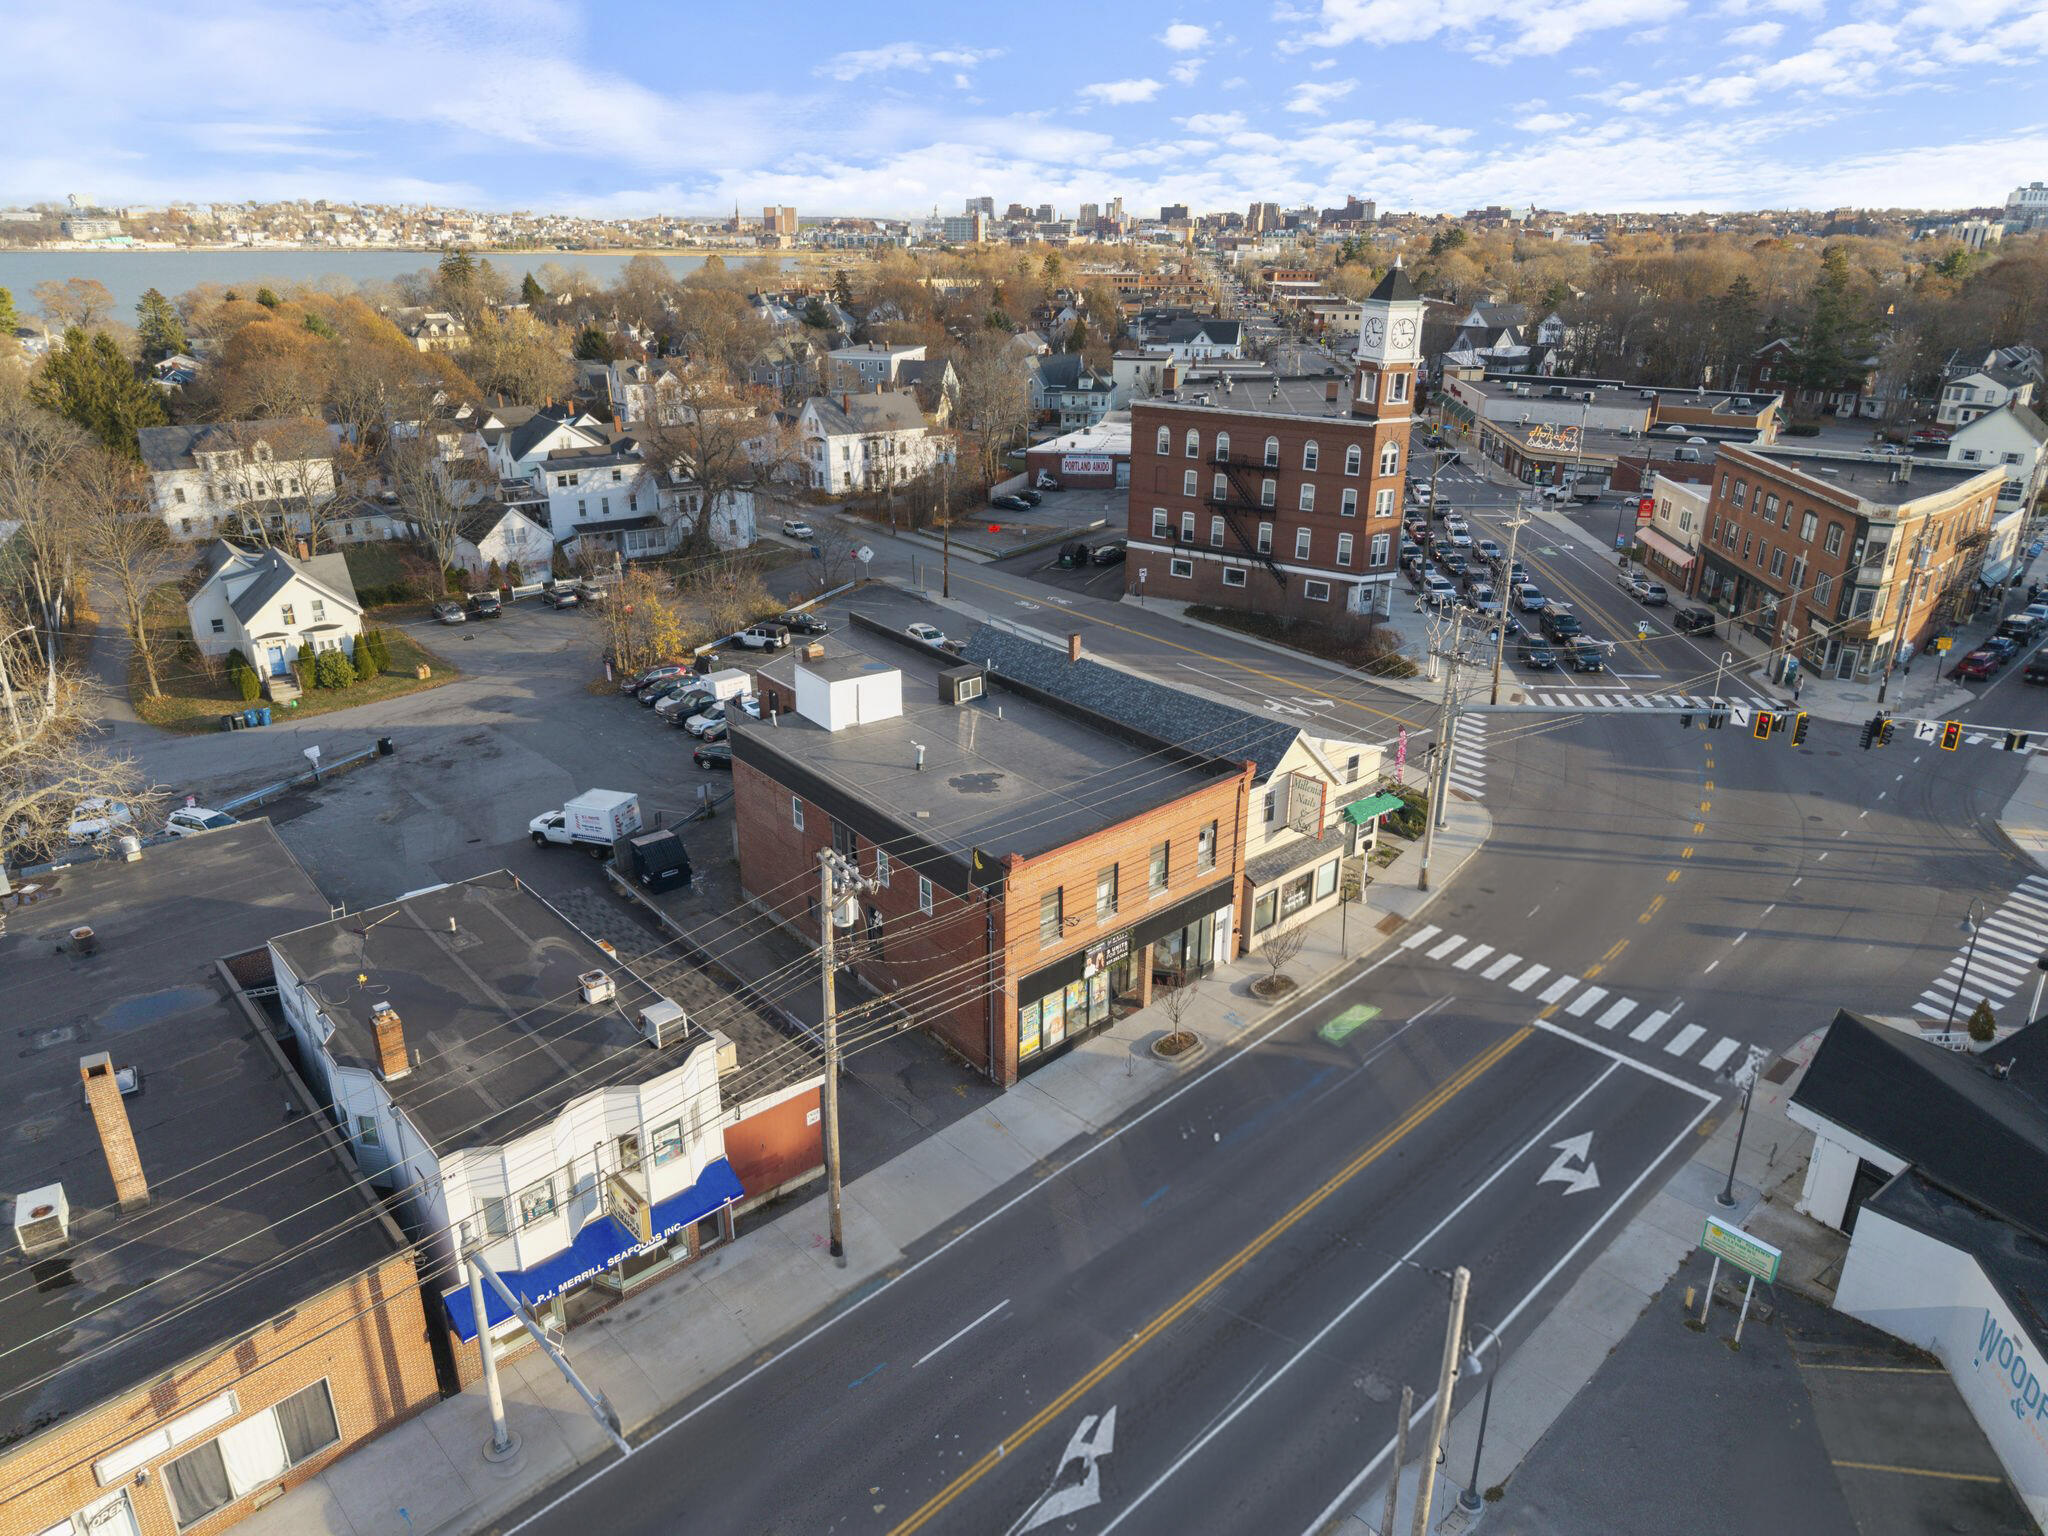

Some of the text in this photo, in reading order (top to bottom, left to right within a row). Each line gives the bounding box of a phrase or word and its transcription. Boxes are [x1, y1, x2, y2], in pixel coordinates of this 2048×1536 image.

[1064, 461, 1110, 472] PORTLAND AIKIDO
[1296, 793, 1316, 807] Nails
[537, 1289, 556, 1304] P.J.
[558, 1264, 605, 1293] MERRILL
[92, 1500, 126, 1528] OPEN
